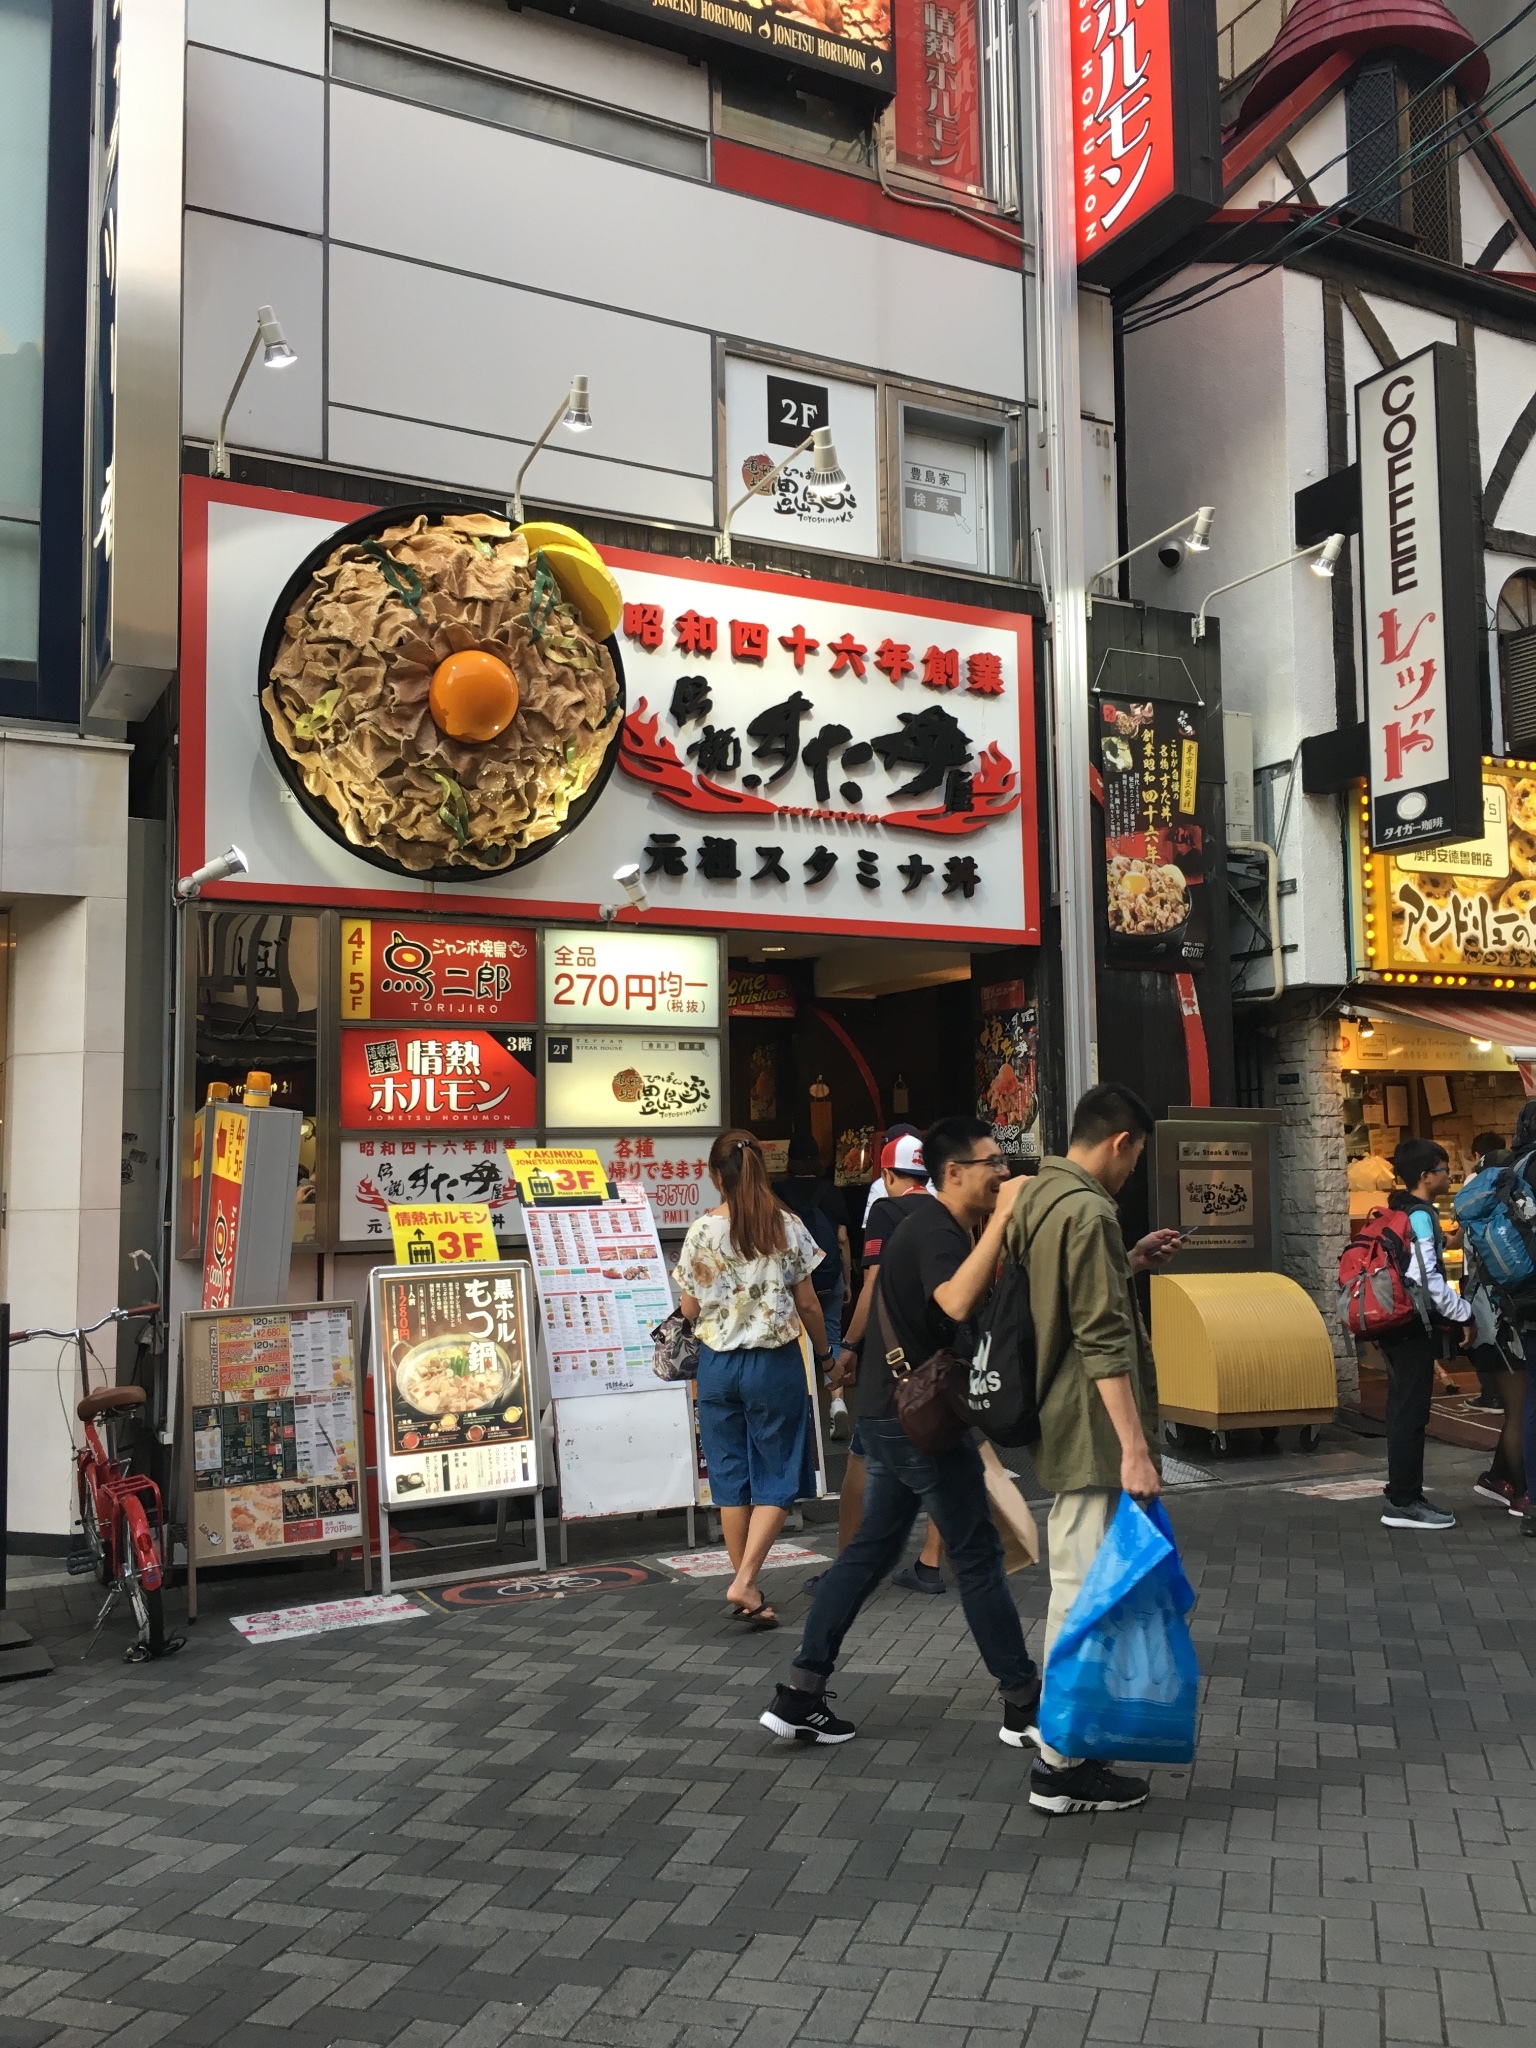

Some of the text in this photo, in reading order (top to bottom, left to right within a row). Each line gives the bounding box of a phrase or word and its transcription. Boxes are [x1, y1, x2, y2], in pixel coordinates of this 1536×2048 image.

[701, 1, 752, 34] HORUMON
[773, 24, 866, 70] JONETSU HORUMON
[924, 3, 959, 167] 情熱ホルモン
[1081, 59, 1098, 242] HORUMON
[780, 398, 818, 429] 2F
[910, 467, 950, 487] 豊島家
[1382, 374, 1417, 596] COFFEE
[912, 491, 949, 513] 検索
[797, 510, 854, 524] TOYOSHIMAKE
[622, 601, 1007, 697] 昭和四十六年創業
[1377, 607, 1436, 783] レッド
[1383, 816, 1444, 840] タイガー珈琲
[643, 833, 983, 899] 元祖スタミナ丼
[1398, 883, 1536, 948] アンドリューの
[432, 938, 507, 959] ジャンボ焼鳥
[554, 945, 597, 967] 全品
[553, 970, 709, 1012] 270円均一
[411, 1002, 498, 1014] TORIJIRO
[406, 1039, 481, 1076] 情熱
[507, 1036, 533, 1053] 3階
[553, 1044, 569, 1055] 2F
[368, 1076, 511, 1114] ホルモン
[659, 1101, 709, 1119] TOYOSHIMAKE
[359, 1139, 518, 1157] 昭和四十六年創業
[524, 1150, 584, 1159] YAKINIKU
[615, 1138, 655, 1159] 各種
[516, 1158, 554, 1166] JONETSU
[555, 1169, 596, 1191] 3F
[395, 1211, 489, 1228] 情熱ホルモン
[437, 1231, 484, 1261] 3F
[399, 1285, 410, 1341] 1280円
[464, 1279, 497, 1374] もつ鍋
